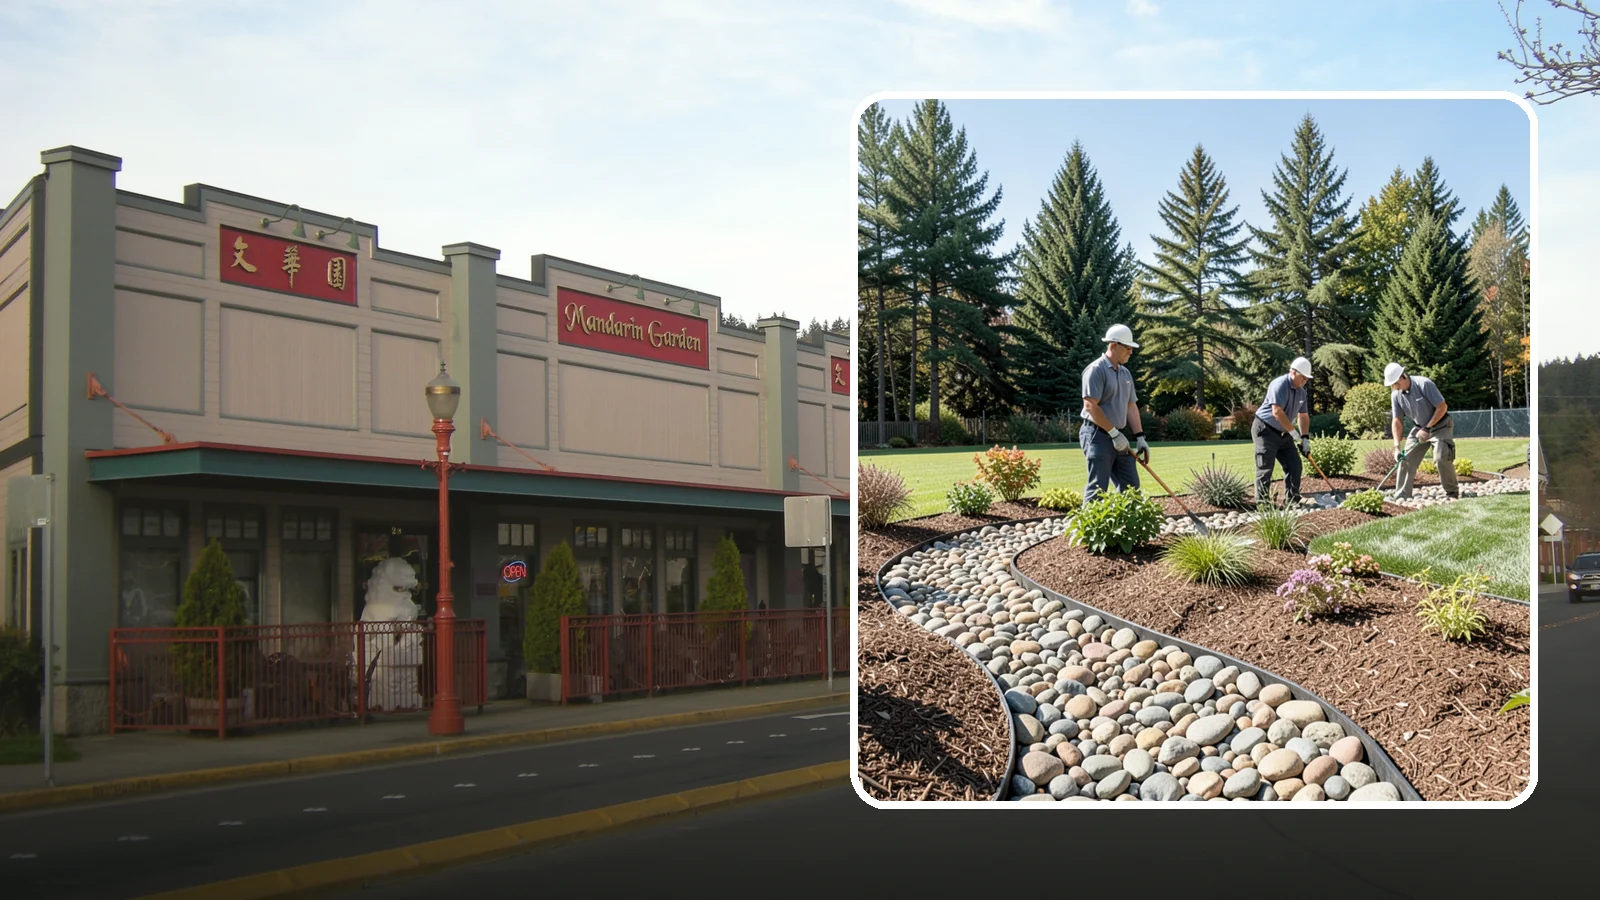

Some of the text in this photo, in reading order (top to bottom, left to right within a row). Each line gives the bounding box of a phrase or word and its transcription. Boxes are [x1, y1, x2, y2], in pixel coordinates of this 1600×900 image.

[230, 235, 347, 291] 文華園
[564, 302, 702, 352] Mandarin Garden
[503, 565, 526, 578] OPEN
